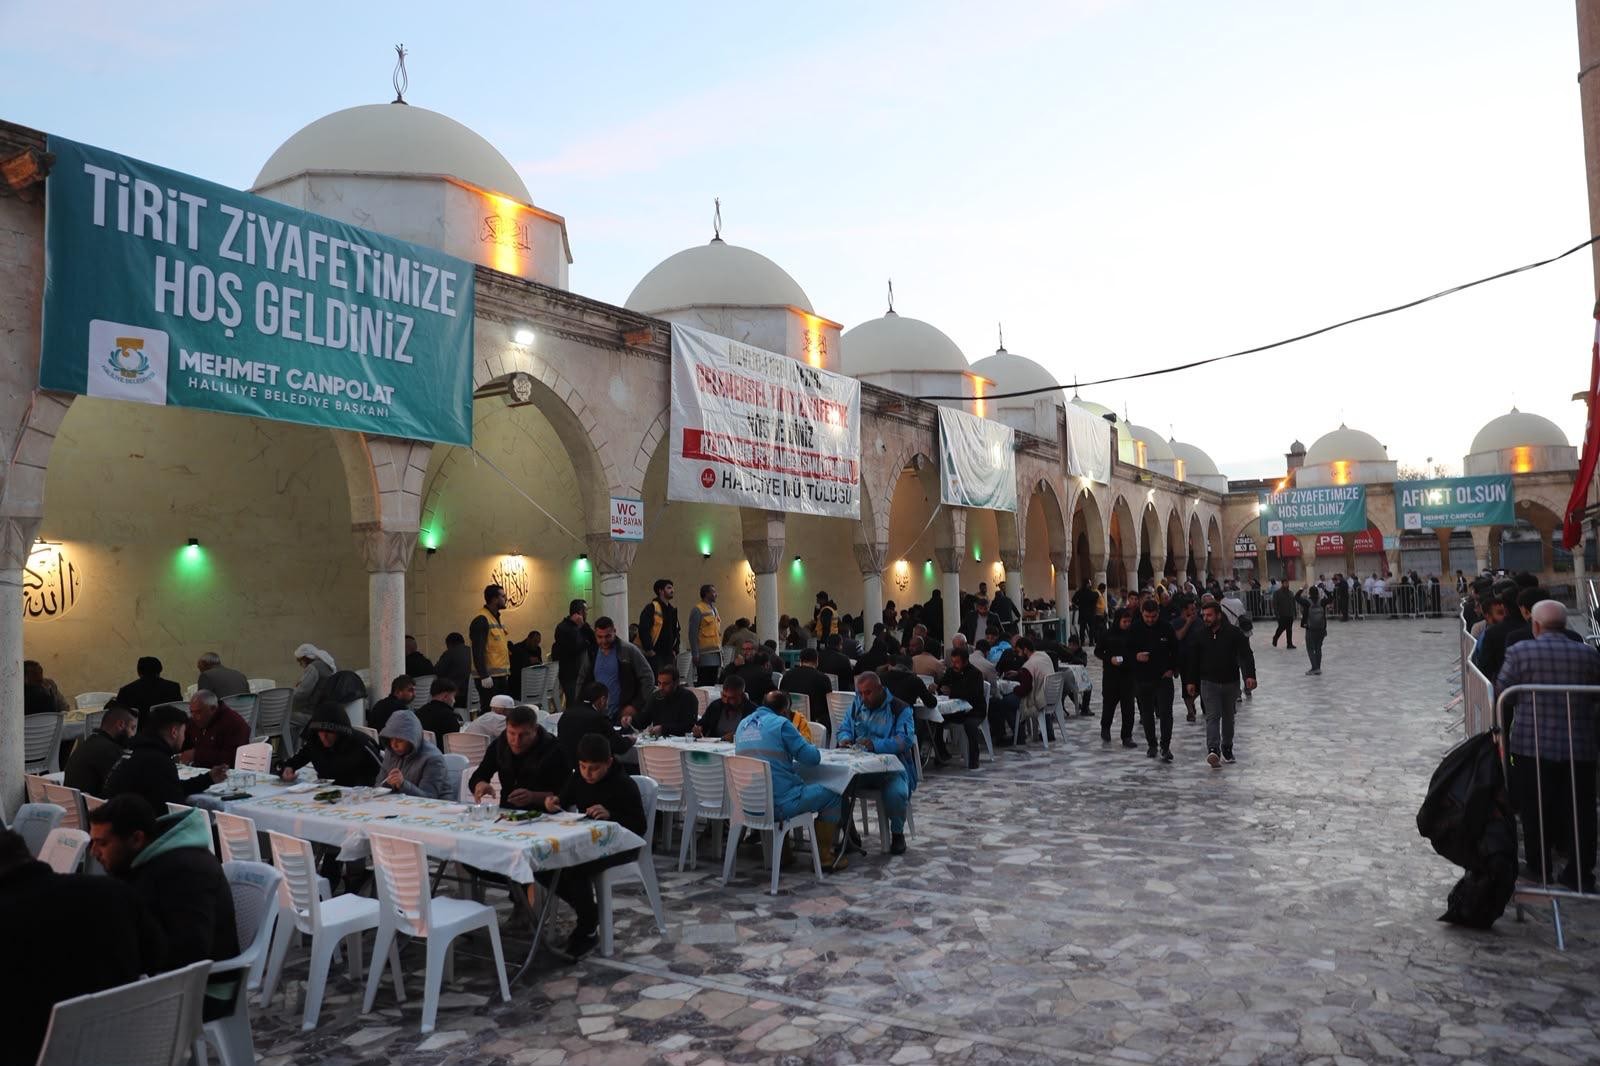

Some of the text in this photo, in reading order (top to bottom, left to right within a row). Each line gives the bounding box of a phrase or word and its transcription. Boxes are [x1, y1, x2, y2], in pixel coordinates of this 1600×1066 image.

[154, 255, 243, 338] HOŞ
[179, 349, 395, 405] MEHMET CANPOLAT
[335, 400, 390, 417] BAŞKANI
[1456, 484, 1507, 504] OLSUN
[617, 503, 636, 516] WC
[1278, 505, 1298, 519] HOŞ
[612, 515, 642, 526] BAY BAYAN
